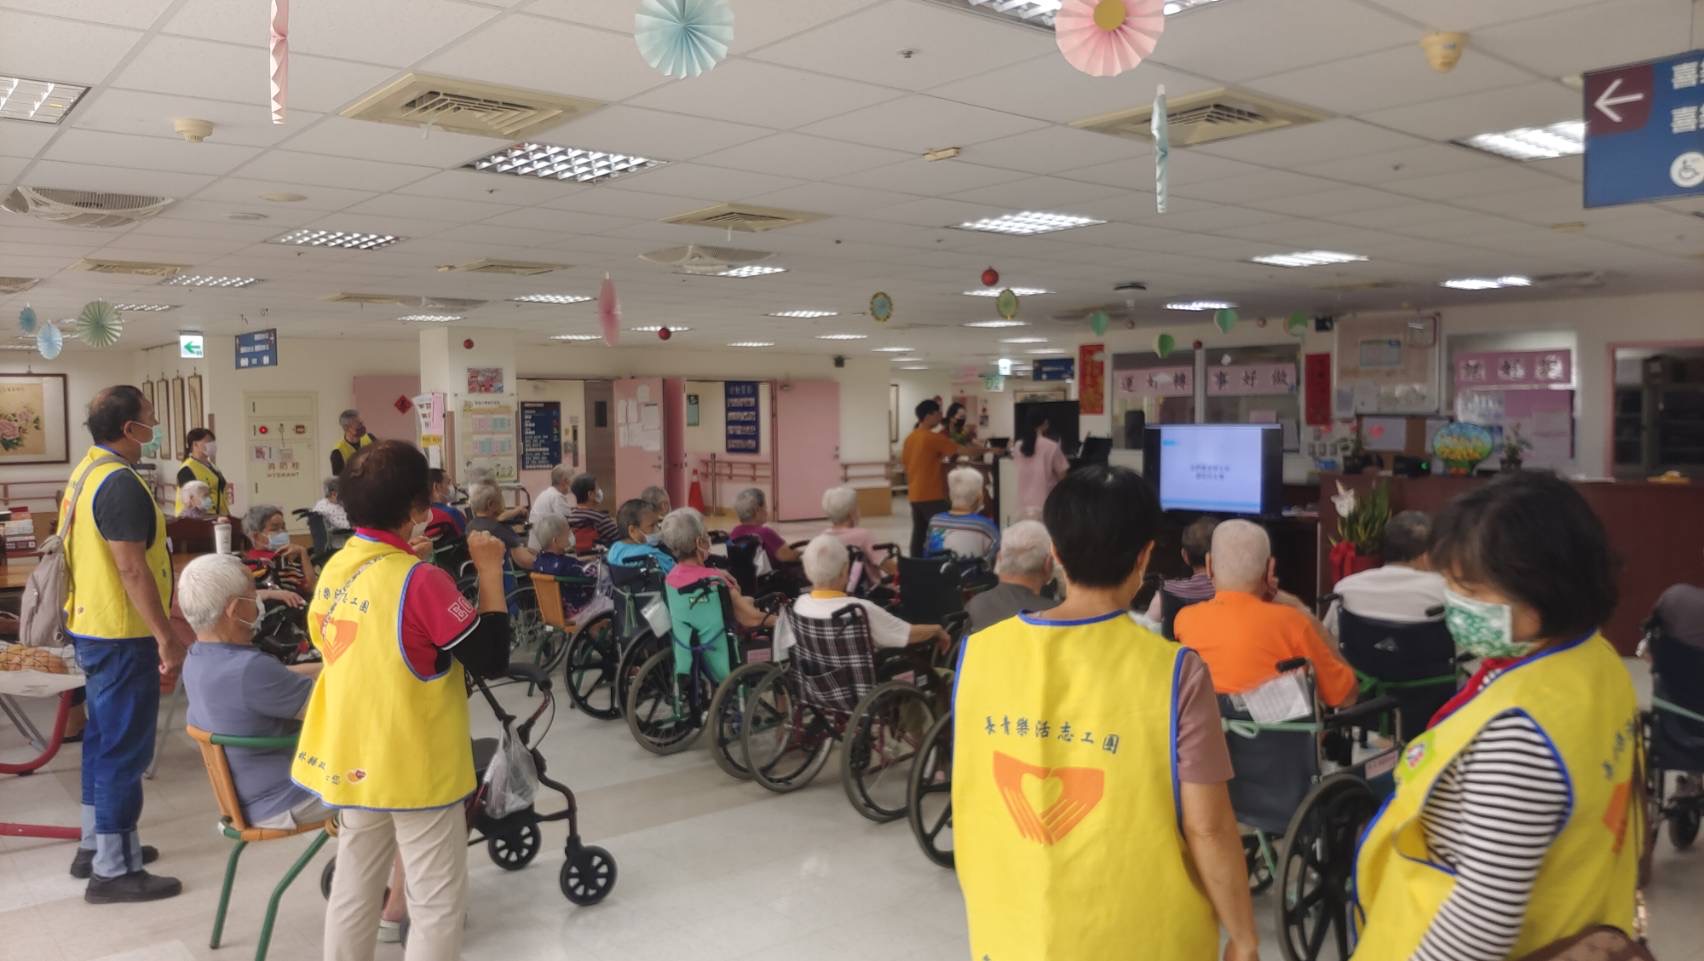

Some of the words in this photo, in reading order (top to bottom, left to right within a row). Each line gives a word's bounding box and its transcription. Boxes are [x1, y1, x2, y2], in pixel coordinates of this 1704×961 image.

[984, 714, 1120, 754] 長青樂活志工團
